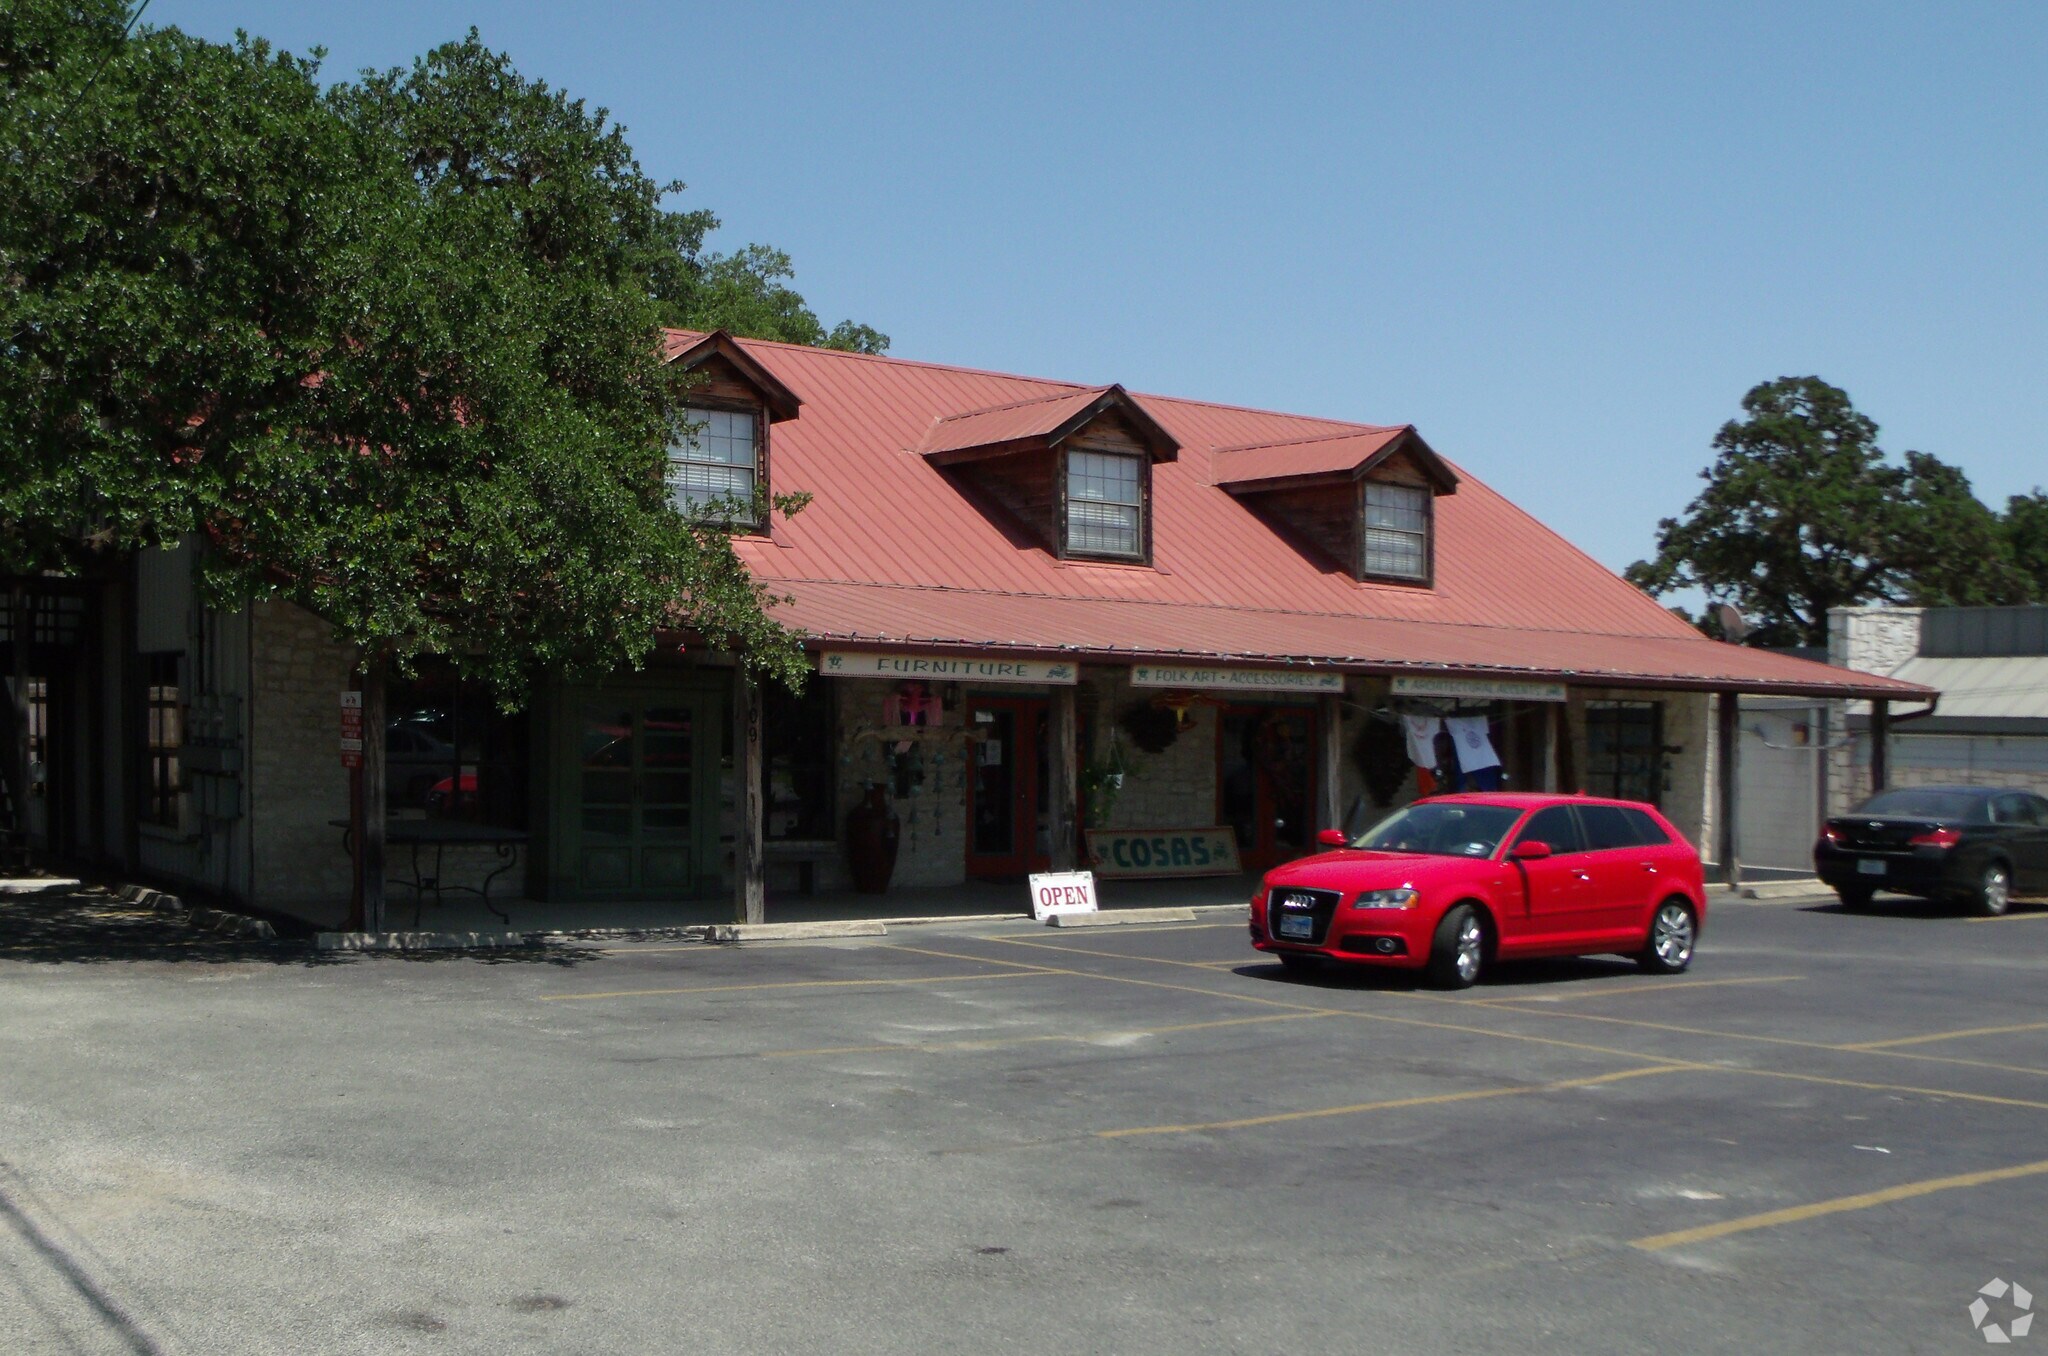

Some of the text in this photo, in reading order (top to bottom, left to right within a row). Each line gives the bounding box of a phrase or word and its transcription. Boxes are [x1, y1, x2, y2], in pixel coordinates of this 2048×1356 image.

[877, 658, 1029, 677] FURNITURE
[1155, 669, 1314, 687] FOLK ART ACCESSORIES
[1113, 837, 1210, 868] COSAS
[1040, 886, 1088, 906] OPEN
